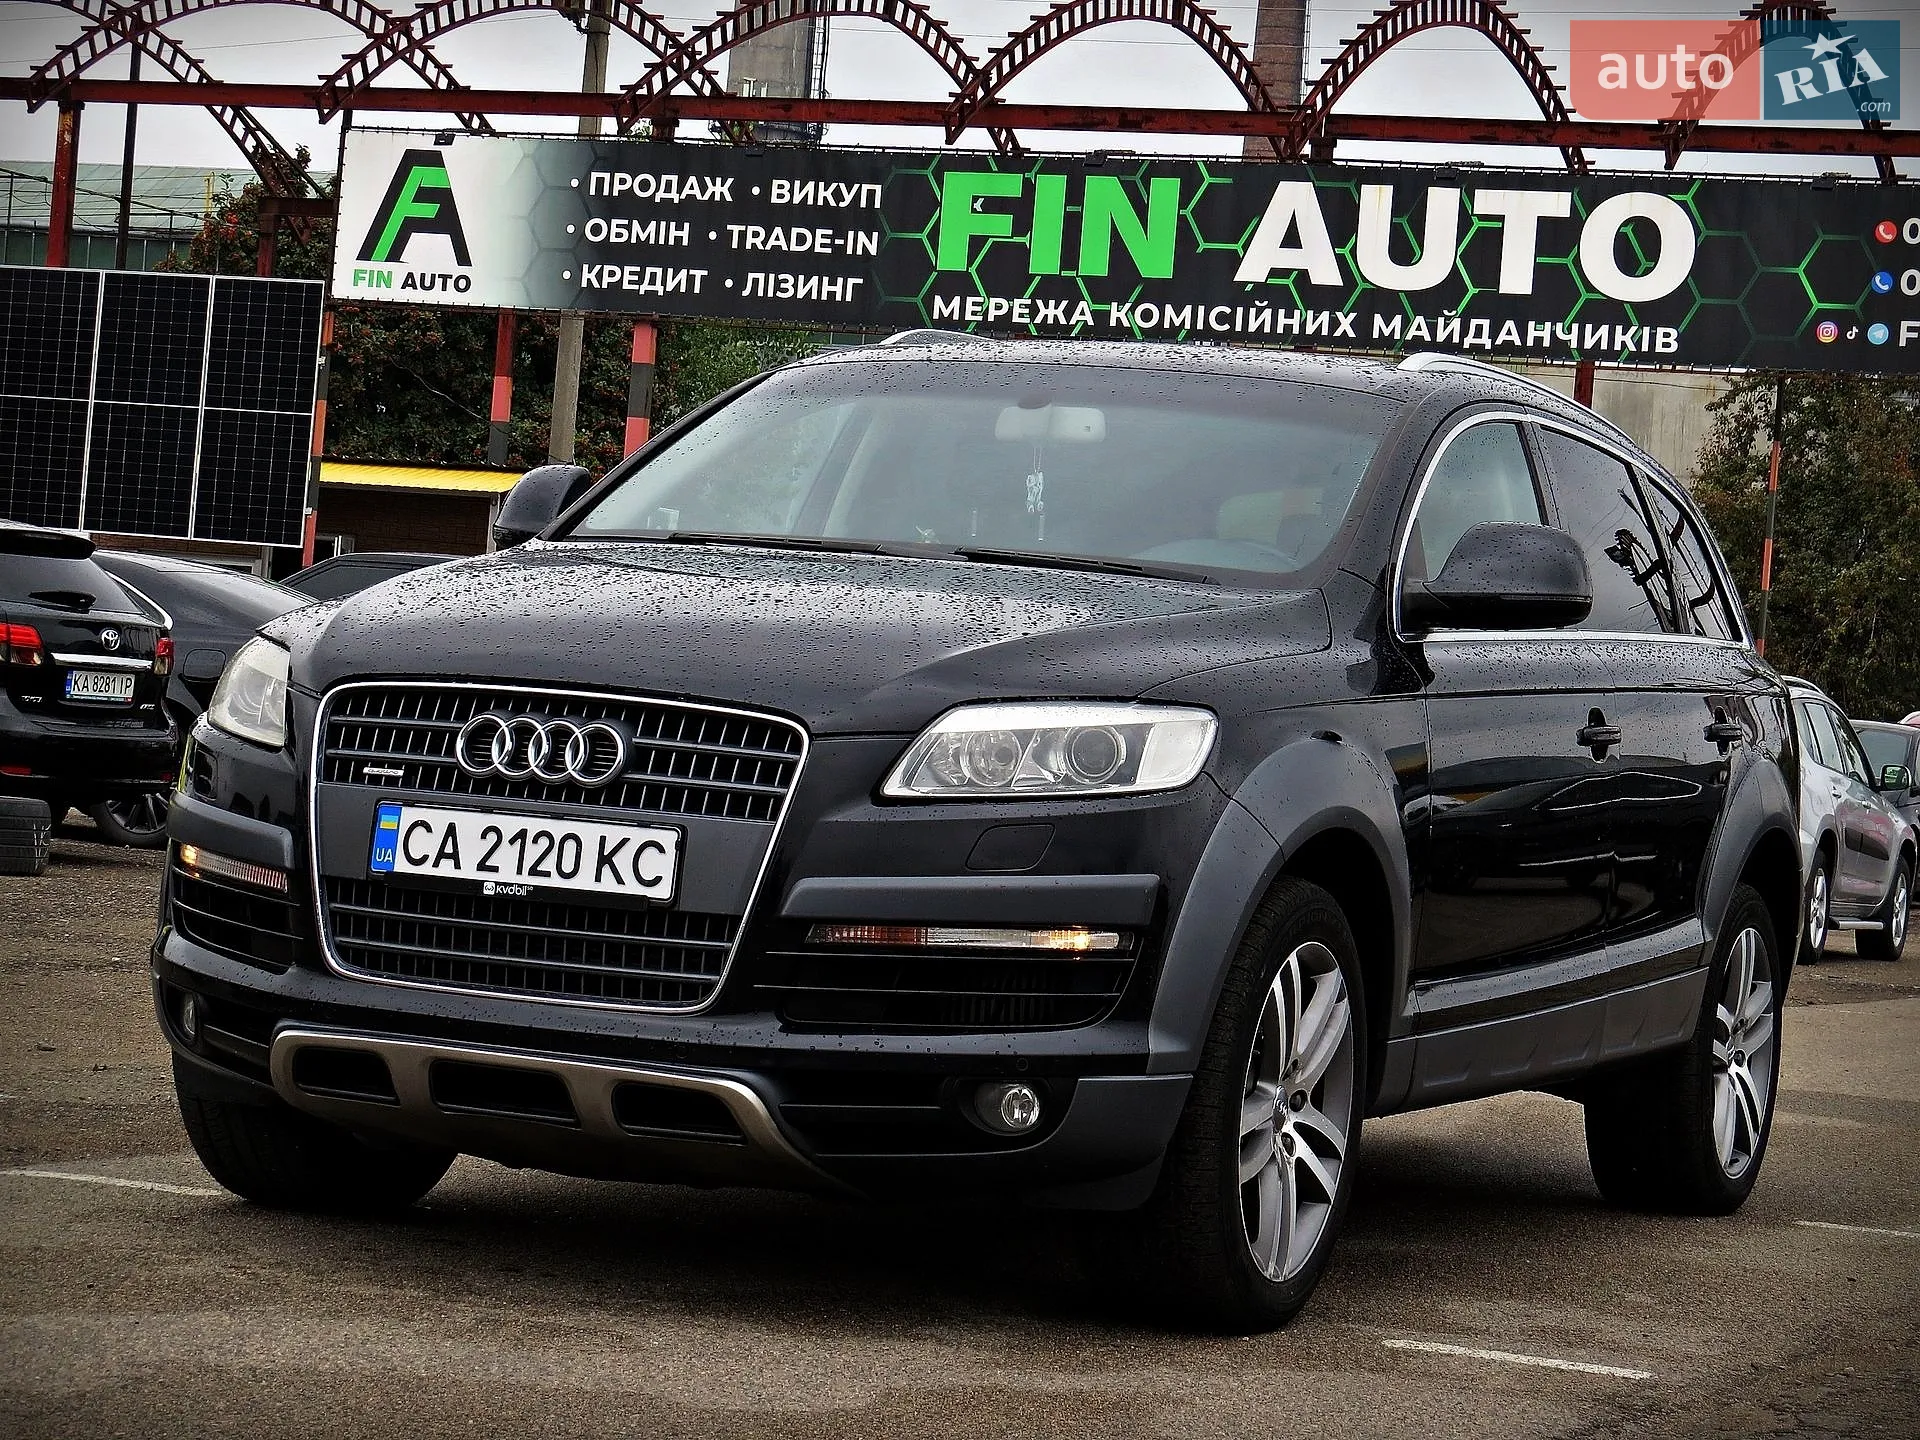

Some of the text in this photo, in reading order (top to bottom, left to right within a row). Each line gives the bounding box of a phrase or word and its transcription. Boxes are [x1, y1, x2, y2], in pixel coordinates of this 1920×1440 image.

[588, 171, 882, 209] ПРОДАЖ ВИКУП
[584, 217, 691, 246] ОБМІН
[726, 223, 880, 256] TRADE-IN
[935, 171, 1697, 303] FIN AUTO
[353, 269, 472, 293] FIN AUTO
[580, 263, 864, 302] КРЕДИТ ЛІЗИНГ
[932, 294, 1680, 354] МЕРЕЖА КОМІСІЙНИХ МАЙДАНЧИКІВ
[73, 674, 89, 692] KA
[92, 675, 117, 693] 8281
[119, 677, 133, 694] IP
[374, 848, 394, 863] UA
[403, 820, 667, 888] CA 2120 KC
